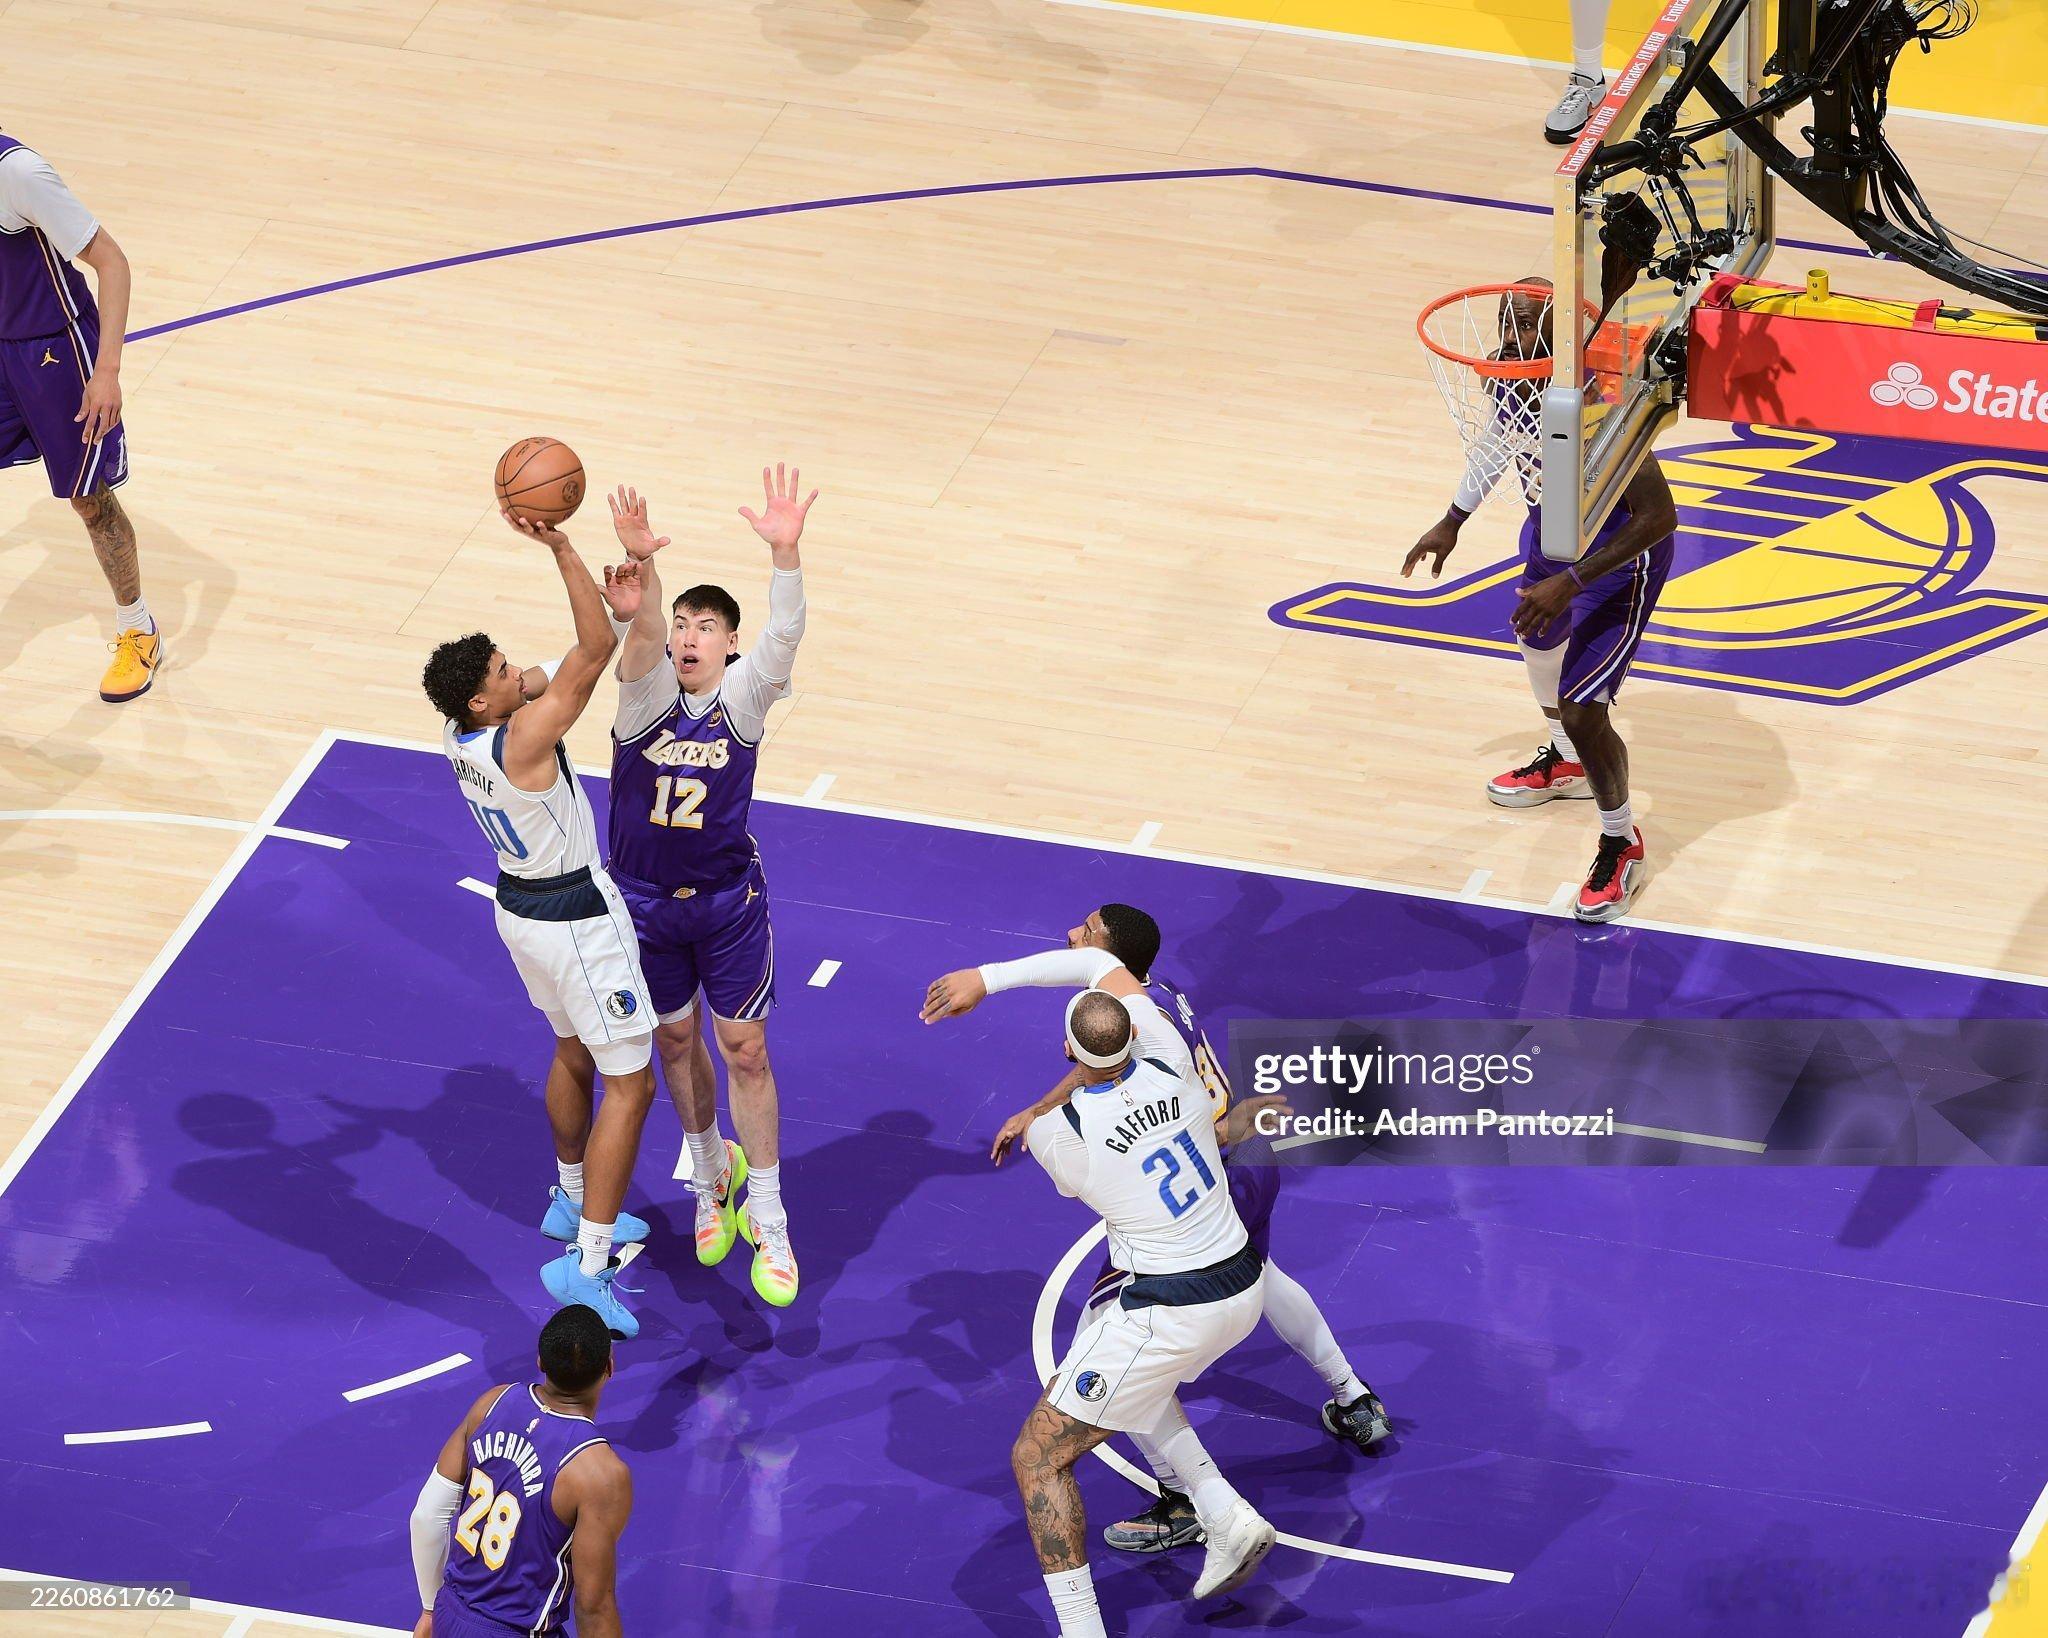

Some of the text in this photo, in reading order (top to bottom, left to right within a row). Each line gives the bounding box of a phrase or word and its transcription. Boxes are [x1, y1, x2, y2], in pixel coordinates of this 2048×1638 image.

[1561, 136, 1598, 172] Emirates
[1612, 62, 1647, 97] Emirates
[453, 757, 494, 798] HRISTIE
[641, 728, 730, 770] LAKERS
[649, 775, 708, 830] 12
[1105, 1096, 1181, 1155] GAFFORD
[1141, 1127, 1217, 1220] 21
[472, 1430, 544, 1498] HACHIMURA
[455, 1467, 522, 1571] 28
